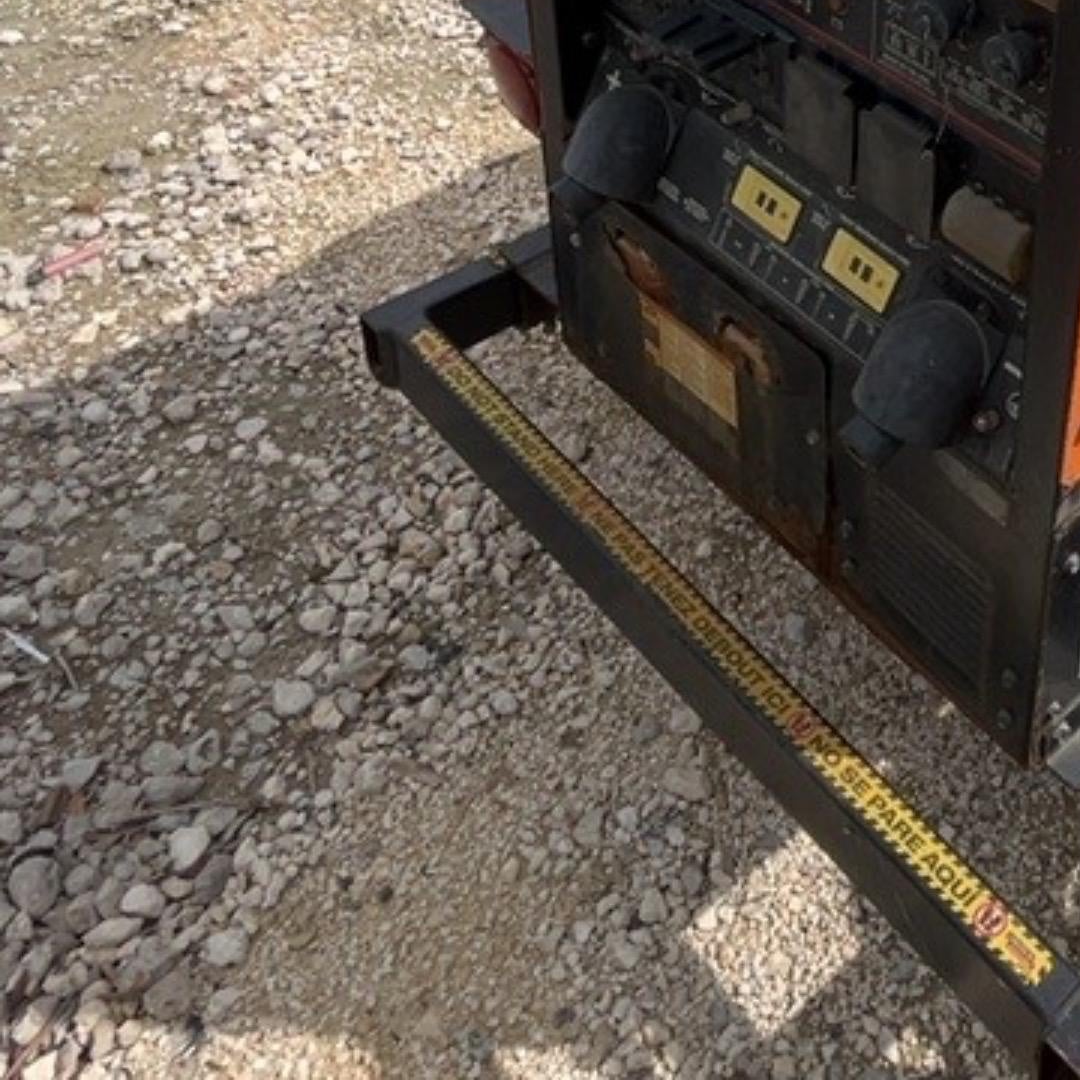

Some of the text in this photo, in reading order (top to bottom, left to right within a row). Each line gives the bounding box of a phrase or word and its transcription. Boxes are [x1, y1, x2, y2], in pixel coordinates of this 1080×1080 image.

[760, 682, 791, 716] ICI
[807, 734, 842, 767] NO
[838, 766, 872, 798] SE
[866, 793, 926, 852] PARE
